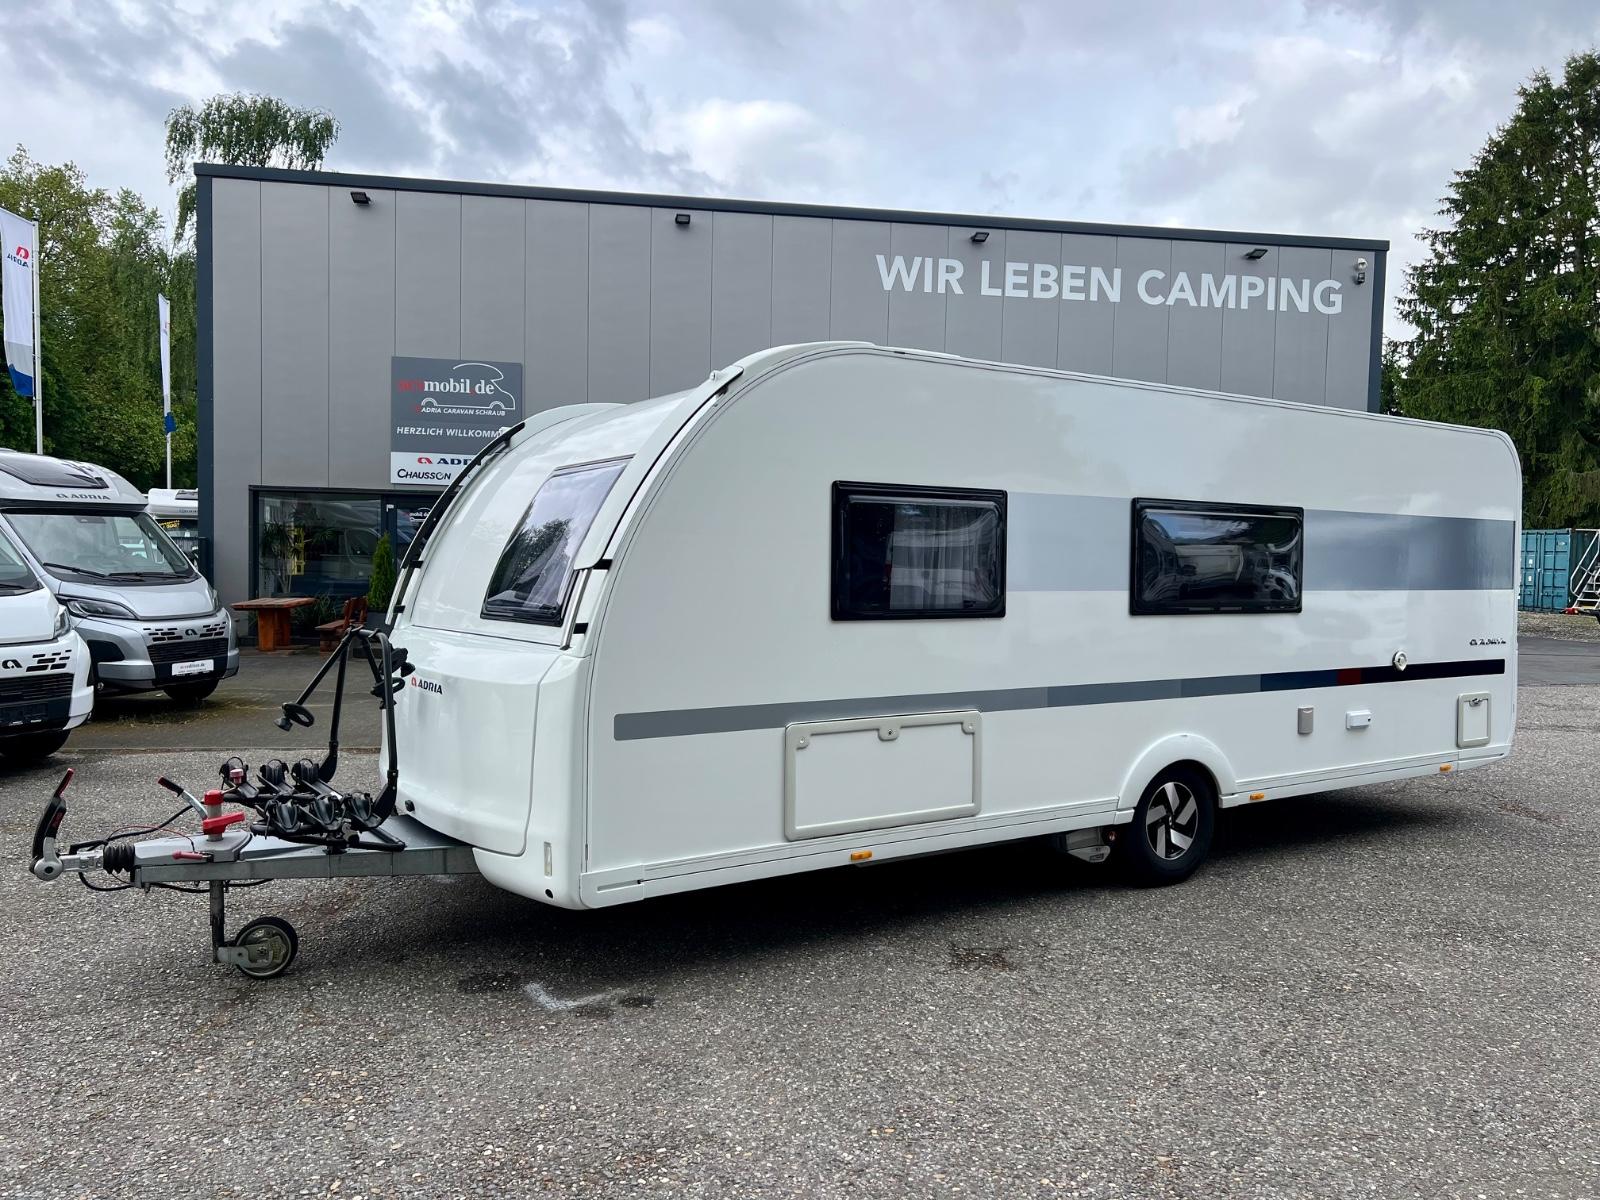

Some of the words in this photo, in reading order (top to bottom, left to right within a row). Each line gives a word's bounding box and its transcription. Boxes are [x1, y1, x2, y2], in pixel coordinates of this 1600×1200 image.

[876, 254, 964, 294] WIR
[980, 260, 1122, 303] LEBEN
[1137, 269, 1343, 315] CAMPING
[396, 426, 443, 436] HERZLICH
[446, 428, 500, 438] WILLKOMM
[417, 679, 443, 695] ADRIA
